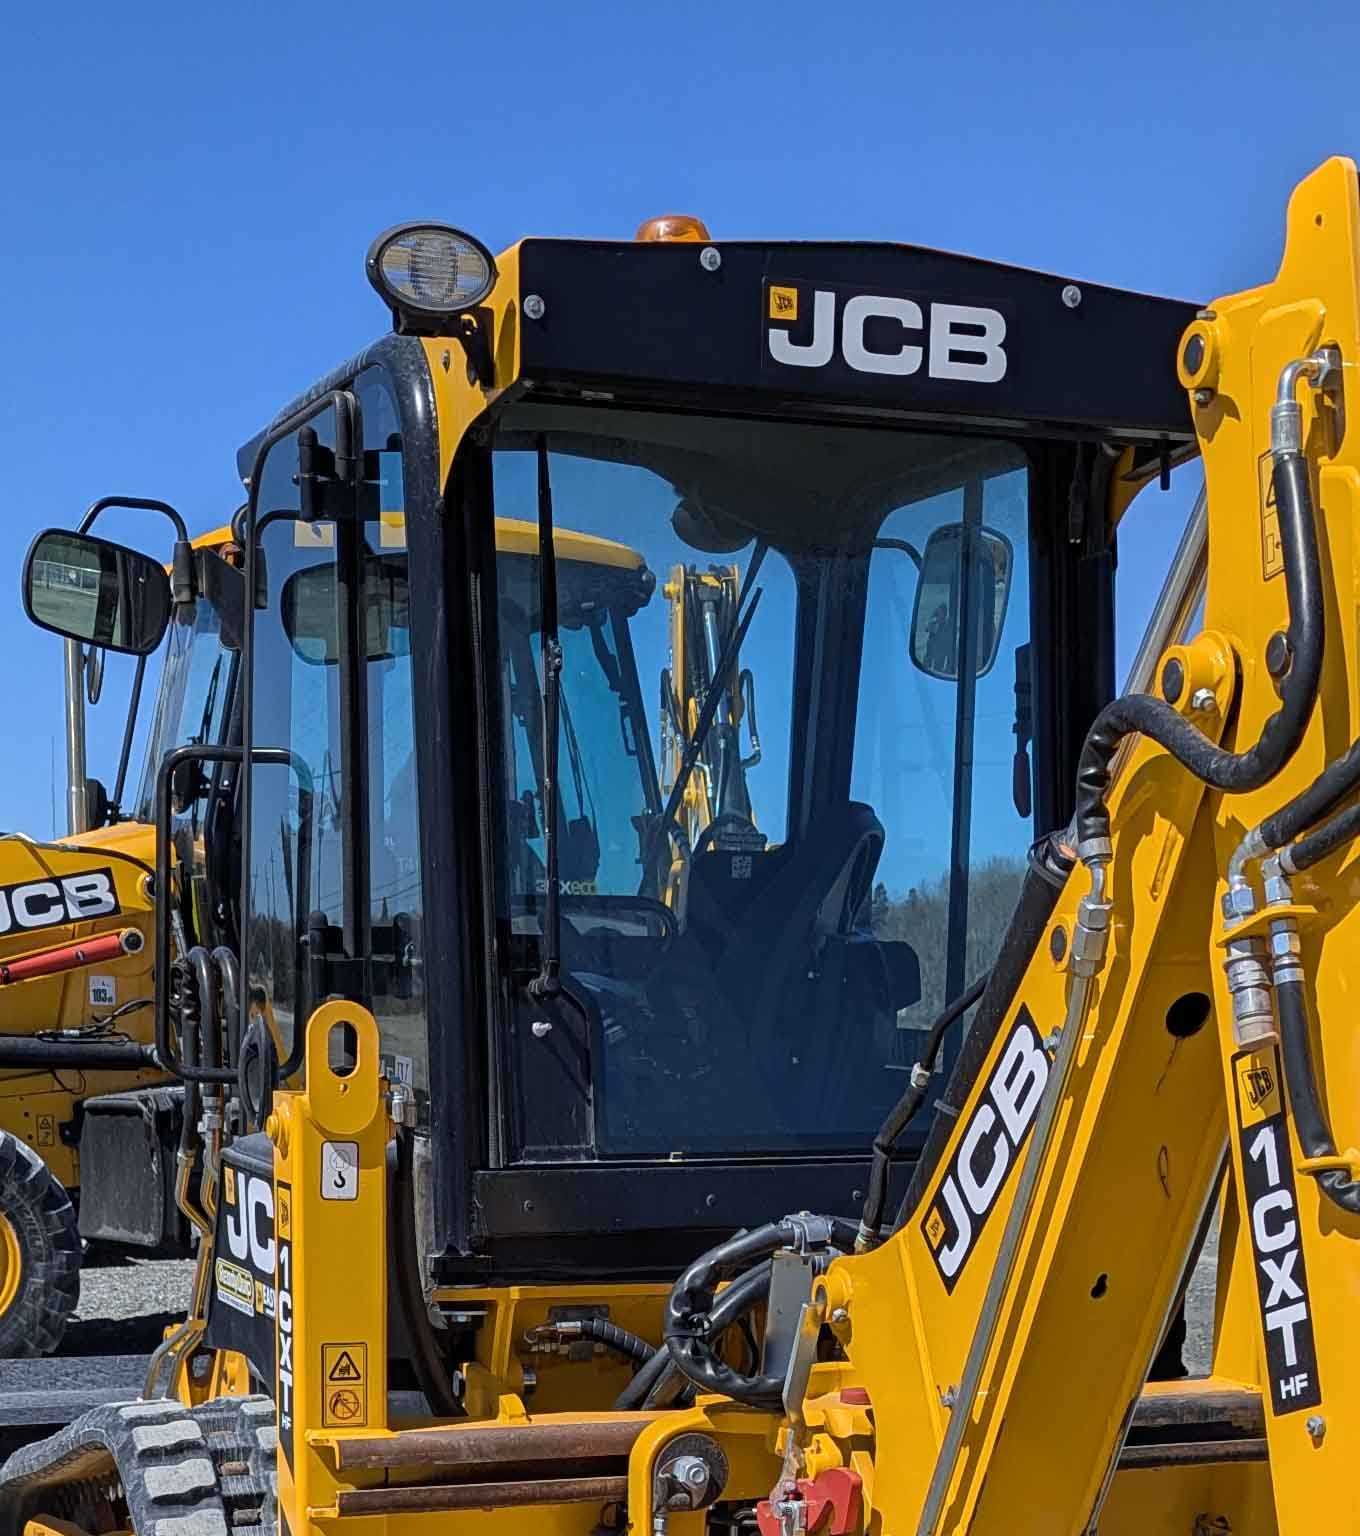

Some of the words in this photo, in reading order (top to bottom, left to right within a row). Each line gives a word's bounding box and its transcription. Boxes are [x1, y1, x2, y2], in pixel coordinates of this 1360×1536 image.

[768, 290, 1008, 383] JCB
[1246, 1070, 1273, 1105] JCB
[938, 1023, 1049, 1278] JCB
[226, 1171, 276, 1275] JC
[1248, 1125, 1309, 1368] 1CXT
[279, 1245, 293, 1413] 1CXT
[1279, 1372, 1309, 1400] HF
